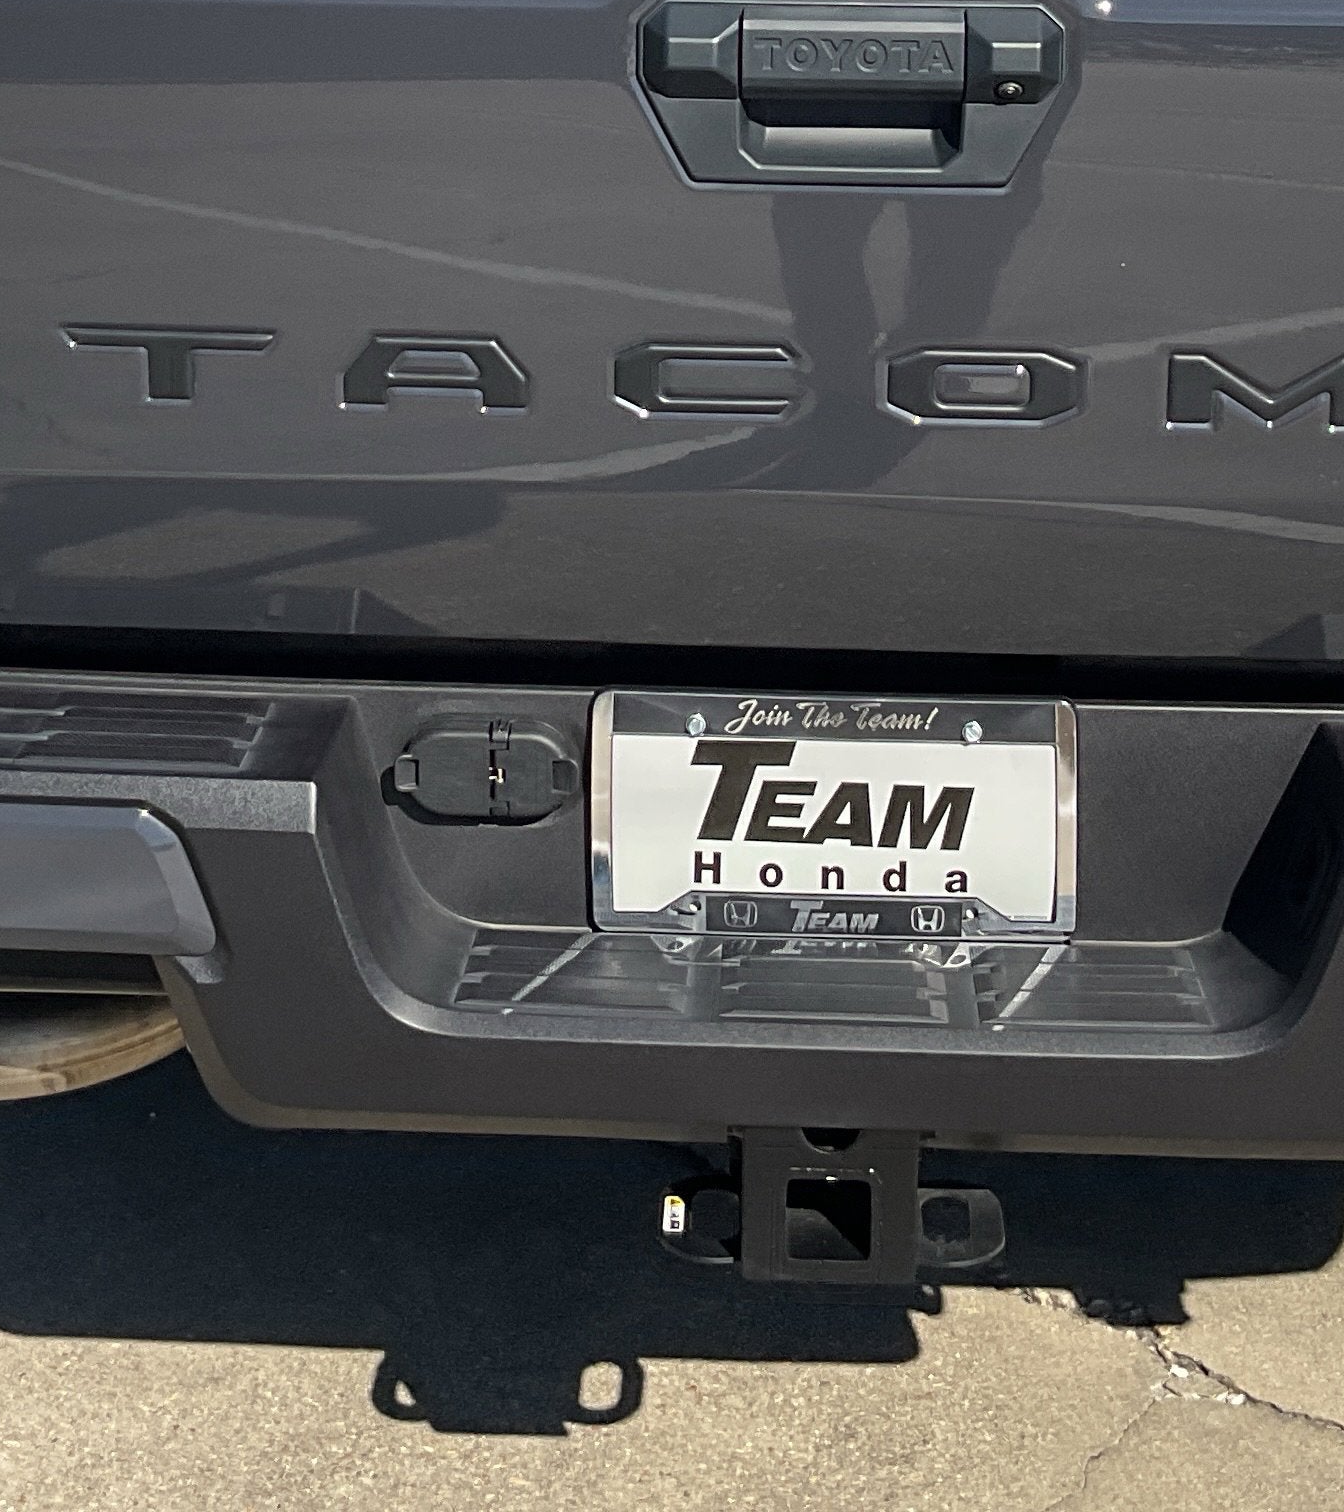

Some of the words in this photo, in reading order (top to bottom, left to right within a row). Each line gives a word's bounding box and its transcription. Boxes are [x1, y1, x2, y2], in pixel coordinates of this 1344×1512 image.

[753, 37, 954, 75] TOYOTA
[724, 699, 793, 733] Join
[796, 701, 846, 729] The
[853, 702, 939, 731] Team!
[690, 739, 976, 852] TEAM
[693, 850, 970, 894] Honda
[789, 900, 880, 933] TEAM
